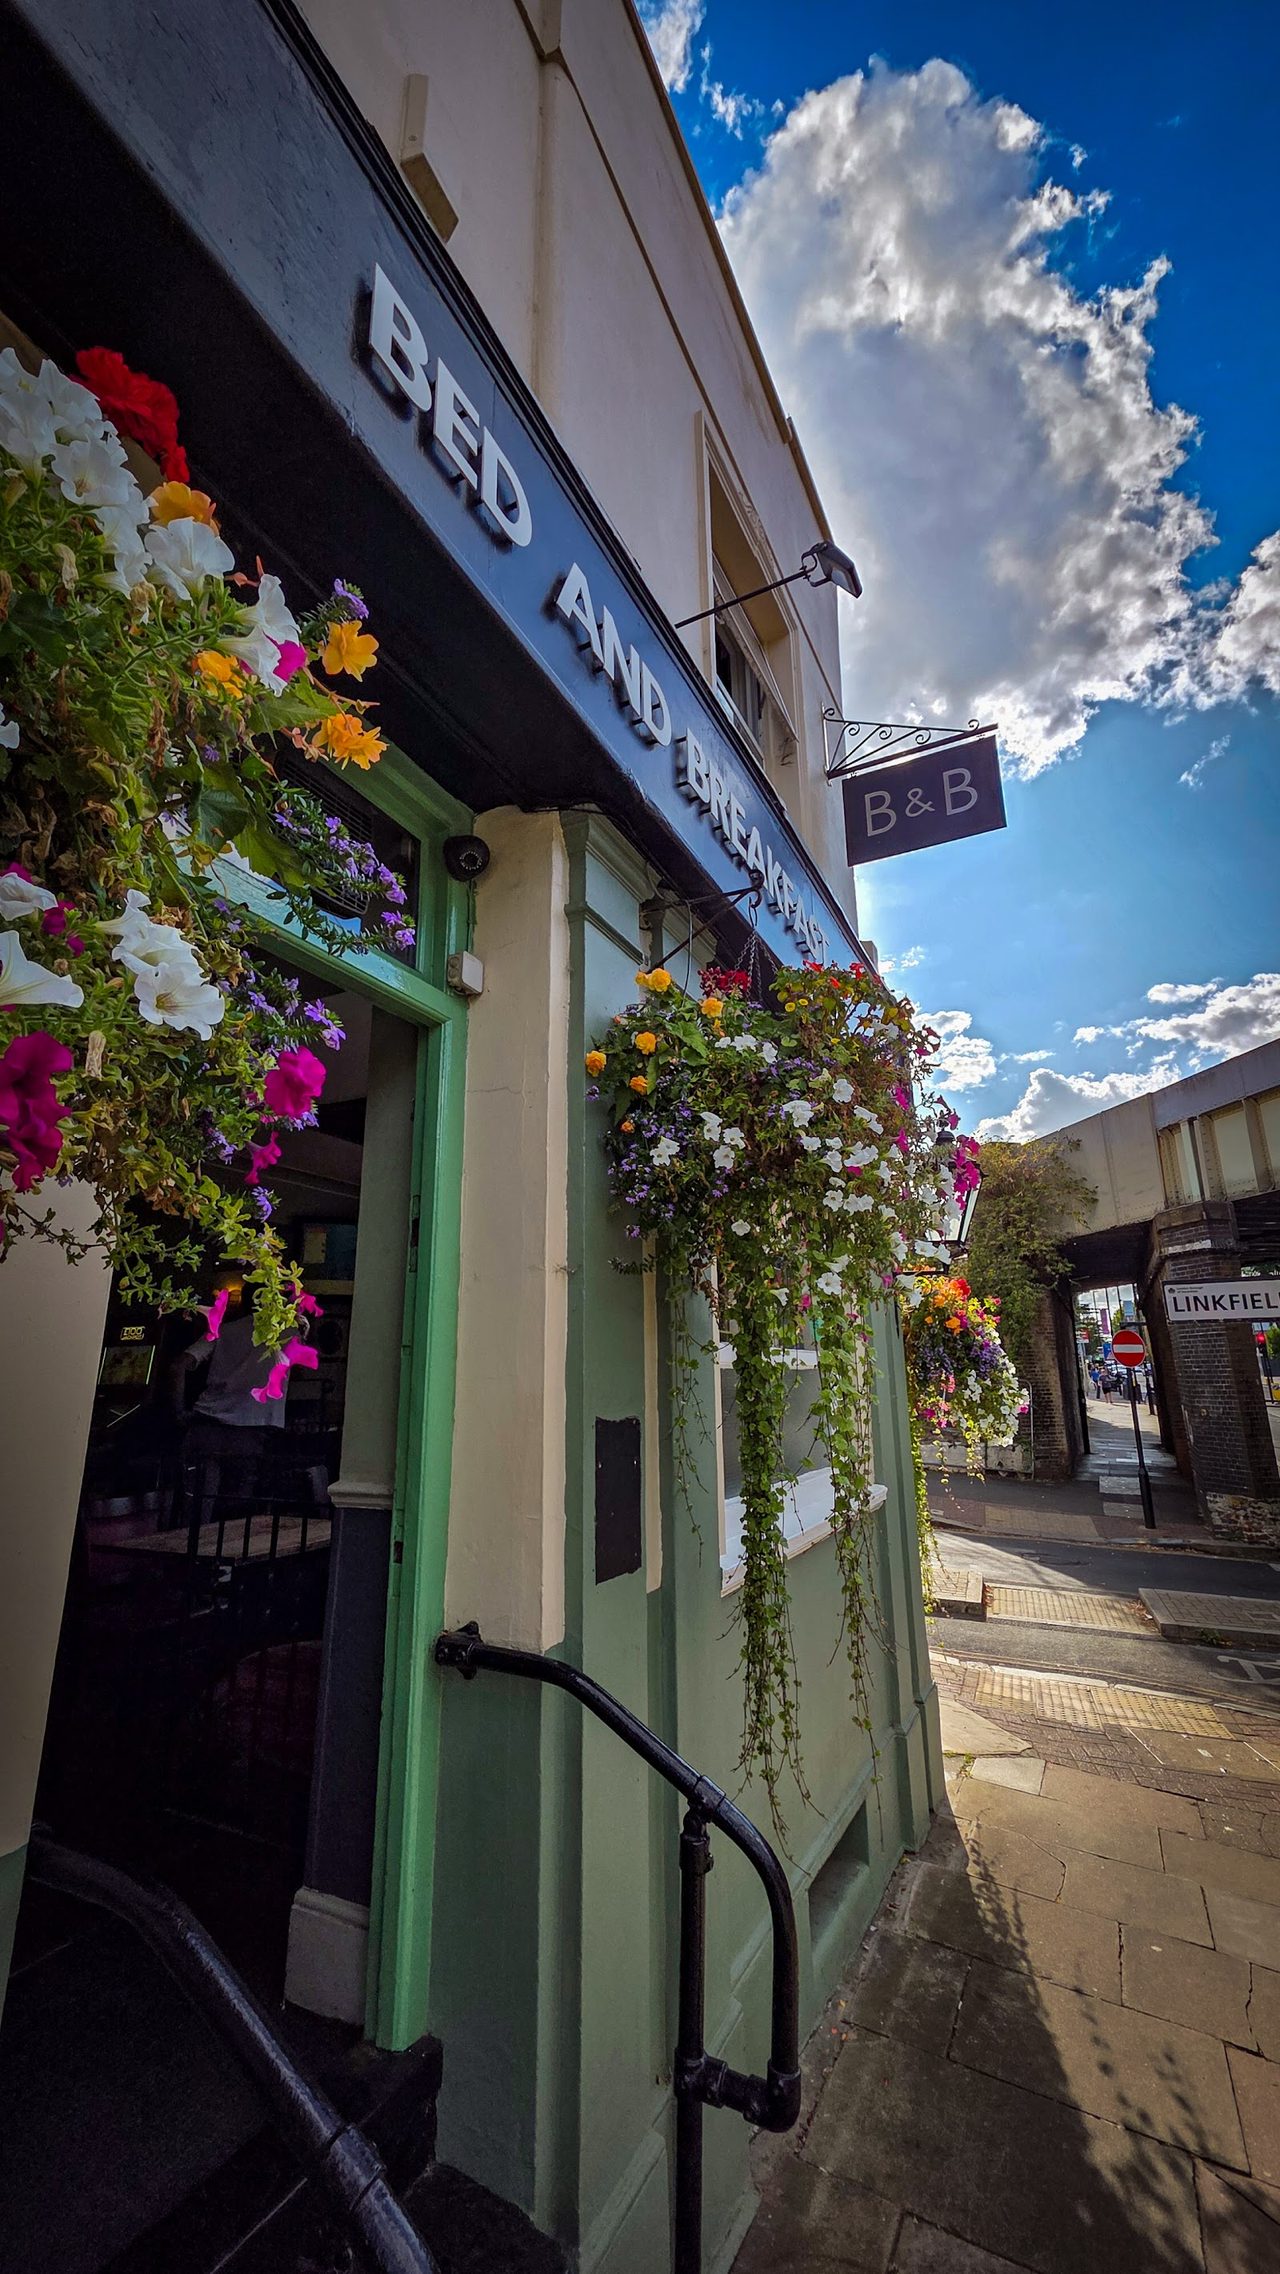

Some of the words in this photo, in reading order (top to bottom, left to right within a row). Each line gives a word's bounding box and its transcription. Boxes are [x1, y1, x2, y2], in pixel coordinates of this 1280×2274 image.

[369, 262, 532, 547] BED
[556, 562, 672, 747] AND
[686, 728, 830, 966] BREAKFAST
[1173, 1292, 1280, 1312] LINKFIEL
